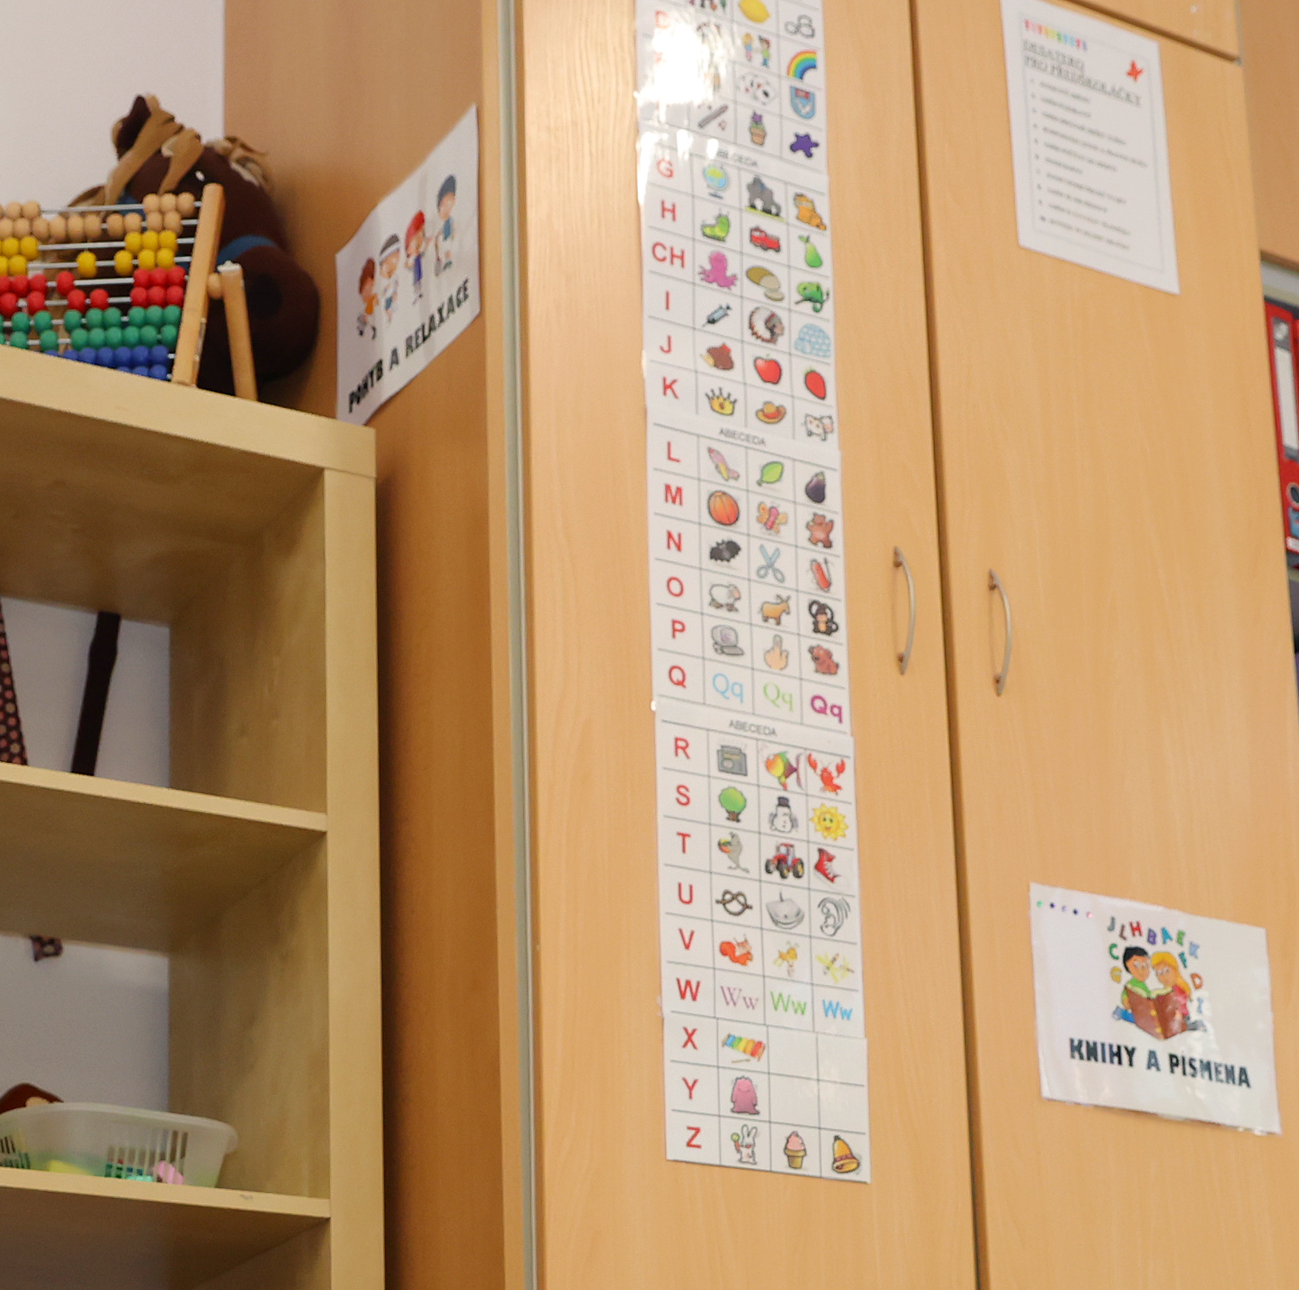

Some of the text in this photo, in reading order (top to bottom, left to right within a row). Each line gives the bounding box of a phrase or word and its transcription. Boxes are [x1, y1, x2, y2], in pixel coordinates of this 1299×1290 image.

[656, 158, 674, 178] G
[660, 200, 678, 222] H
[651, 242, 686, 268] CH
[389, 345, 400, 371] A
[405, 277, 470, 358] RELAXACE
[660, 336, 673, 355] J
[662, 376, 679, 398] K
[666, 441, 681, 463] L
[664, 483, 684, 506] M
[666, 530, 683, 553] N
[666, 575, 685, 598] O
[671, 618, 687, 639] P
[668, 664, 843, 724] Q Qq Qq Qq
[729, 719, 778, 737] ABECEDA
[674, 736, 691, 759] R
[675, 784, 691, 808] S
[676, 831, 692, 854] T
[677, 882, 694, 906] U
[1107, 916, 1116, 932] J
[1119, 923, 1127, 941] L
[1129, 921, 1143, 937] H
[1161, 927, 1173, 944] A
[678, 928, 696, 951] V
[1147, 927, 1157, 945] B
[1108, 942, 1119, 960] C
[1190, 972, 1204, 990] D
[676, 977, 854, 1021] W Ww Ww Ww
[681, 1026, 698, 1050] X
[1069, 1037, 1136, 1068] KNIHY
[1146, 1049, 1161, 1072] A
[682, 1077, 699, 1100] Y
[686, 1125, 702, 1150] Z
